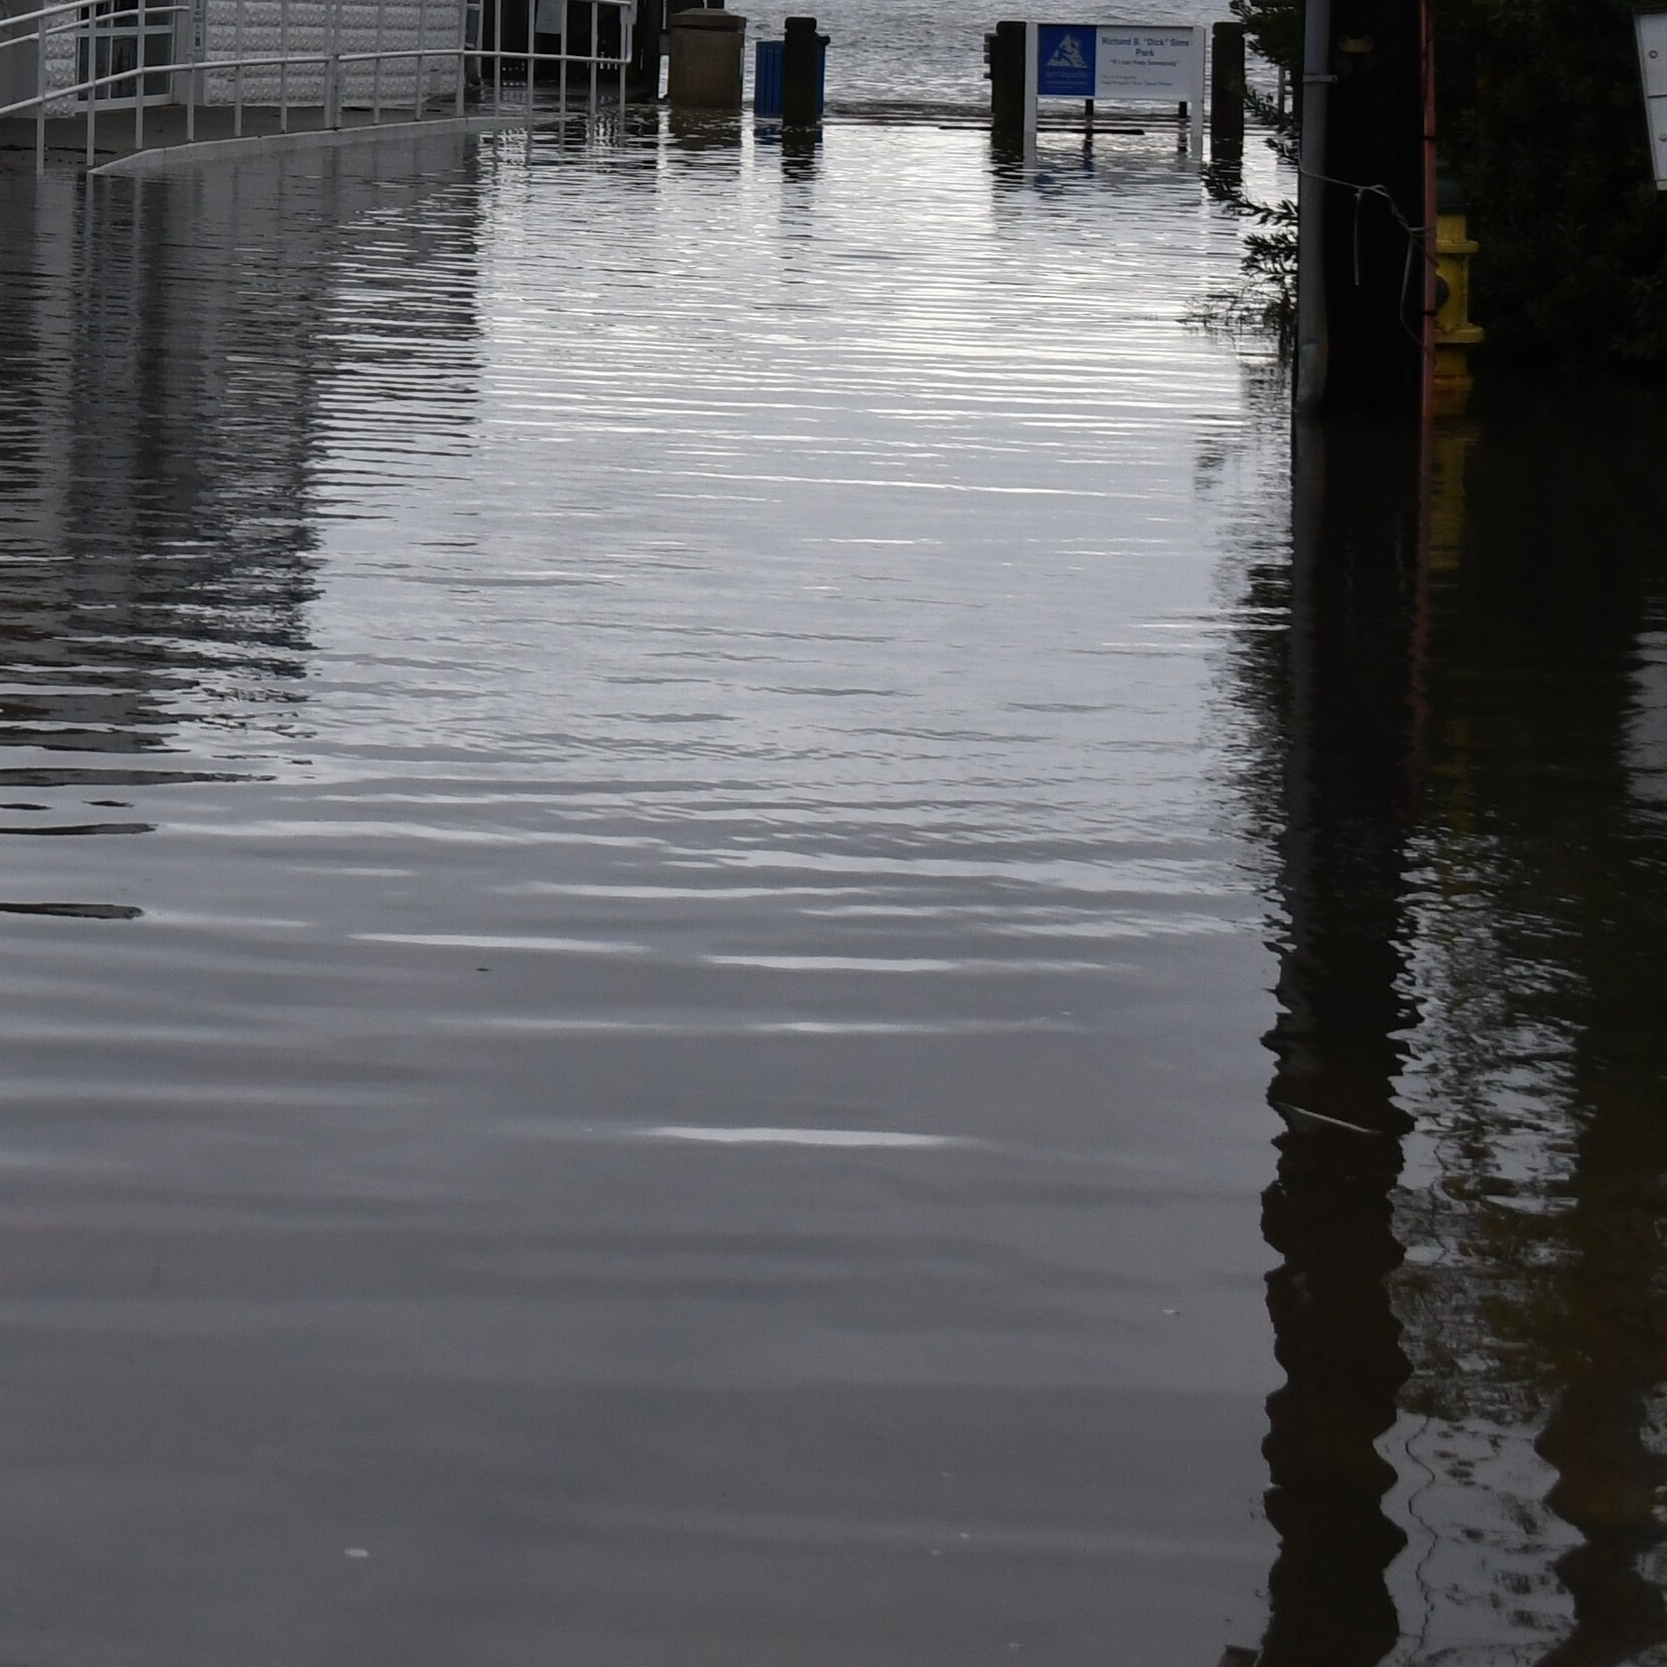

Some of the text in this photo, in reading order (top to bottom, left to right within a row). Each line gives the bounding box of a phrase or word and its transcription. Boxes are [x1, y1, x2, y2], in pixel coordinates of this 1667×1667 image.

[1101, 36, 1132, 45] Richard
[1170, 38, 1189, 46] Sims
[1135, 47, 1155, 56] Park
